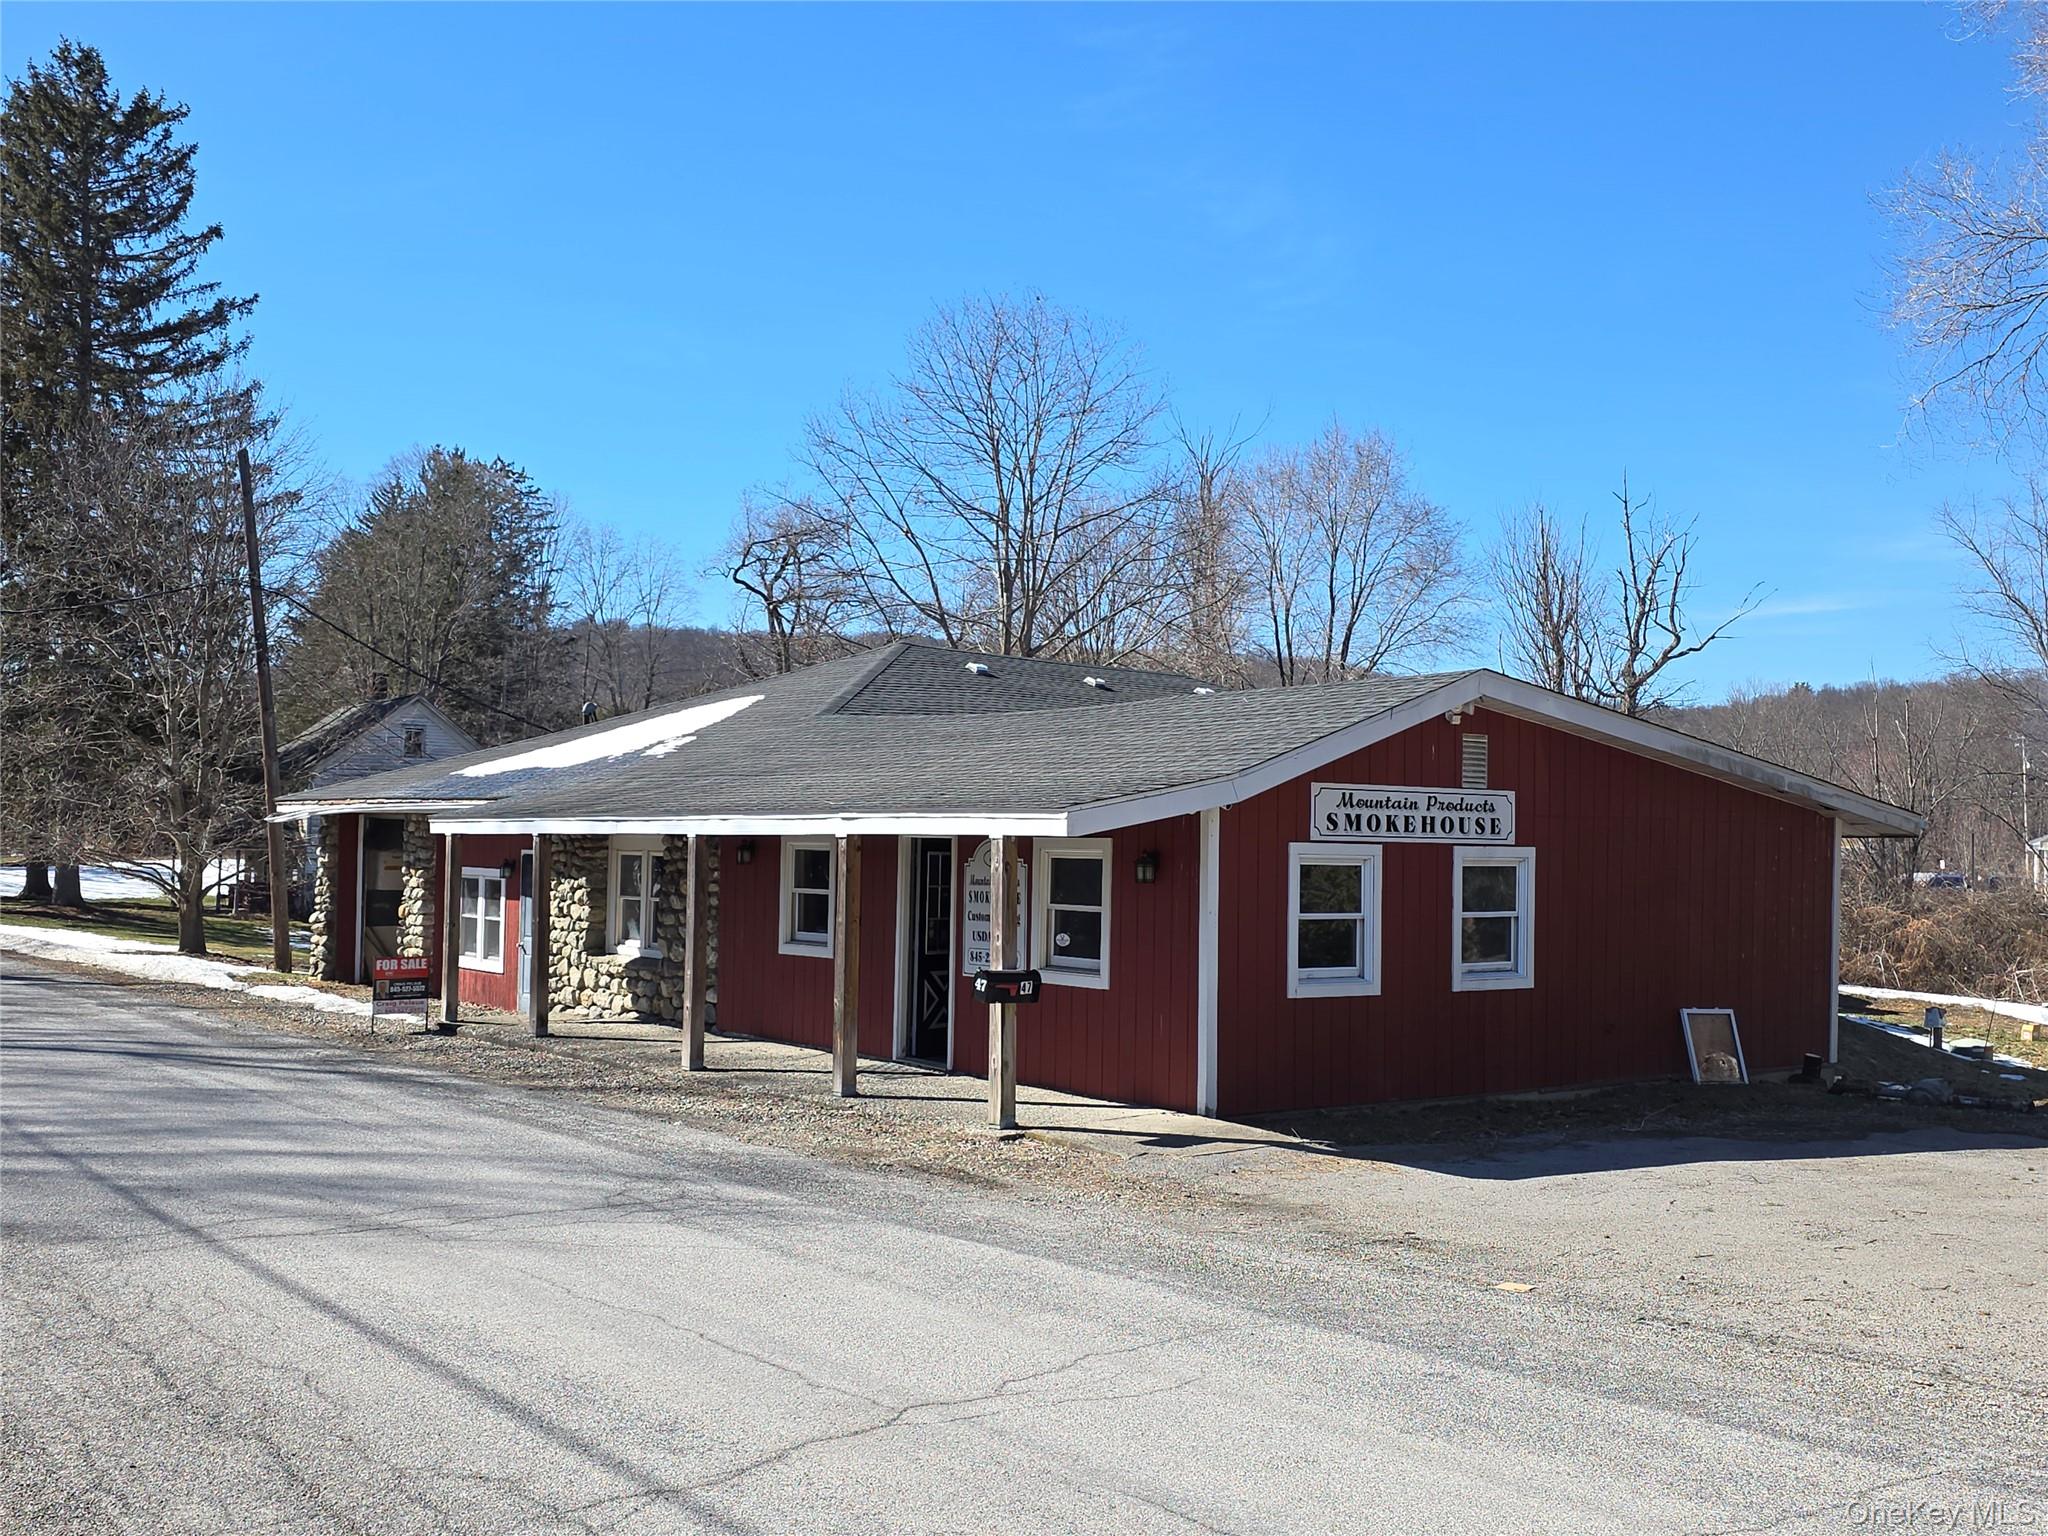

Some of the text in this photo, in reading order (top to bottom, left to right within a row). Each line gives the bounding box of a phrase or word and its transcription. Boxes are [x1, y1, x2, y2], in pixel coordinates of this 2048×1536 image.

[1336, 792, 1496, 813] Mountain Products
[1326, 812, 1502, 836] SMOKEHOUSE
[376, 958, 428, 971] FOR SALE
[974, 978, 987, 992] 47
[1021, 982, 1032, 994] 47
